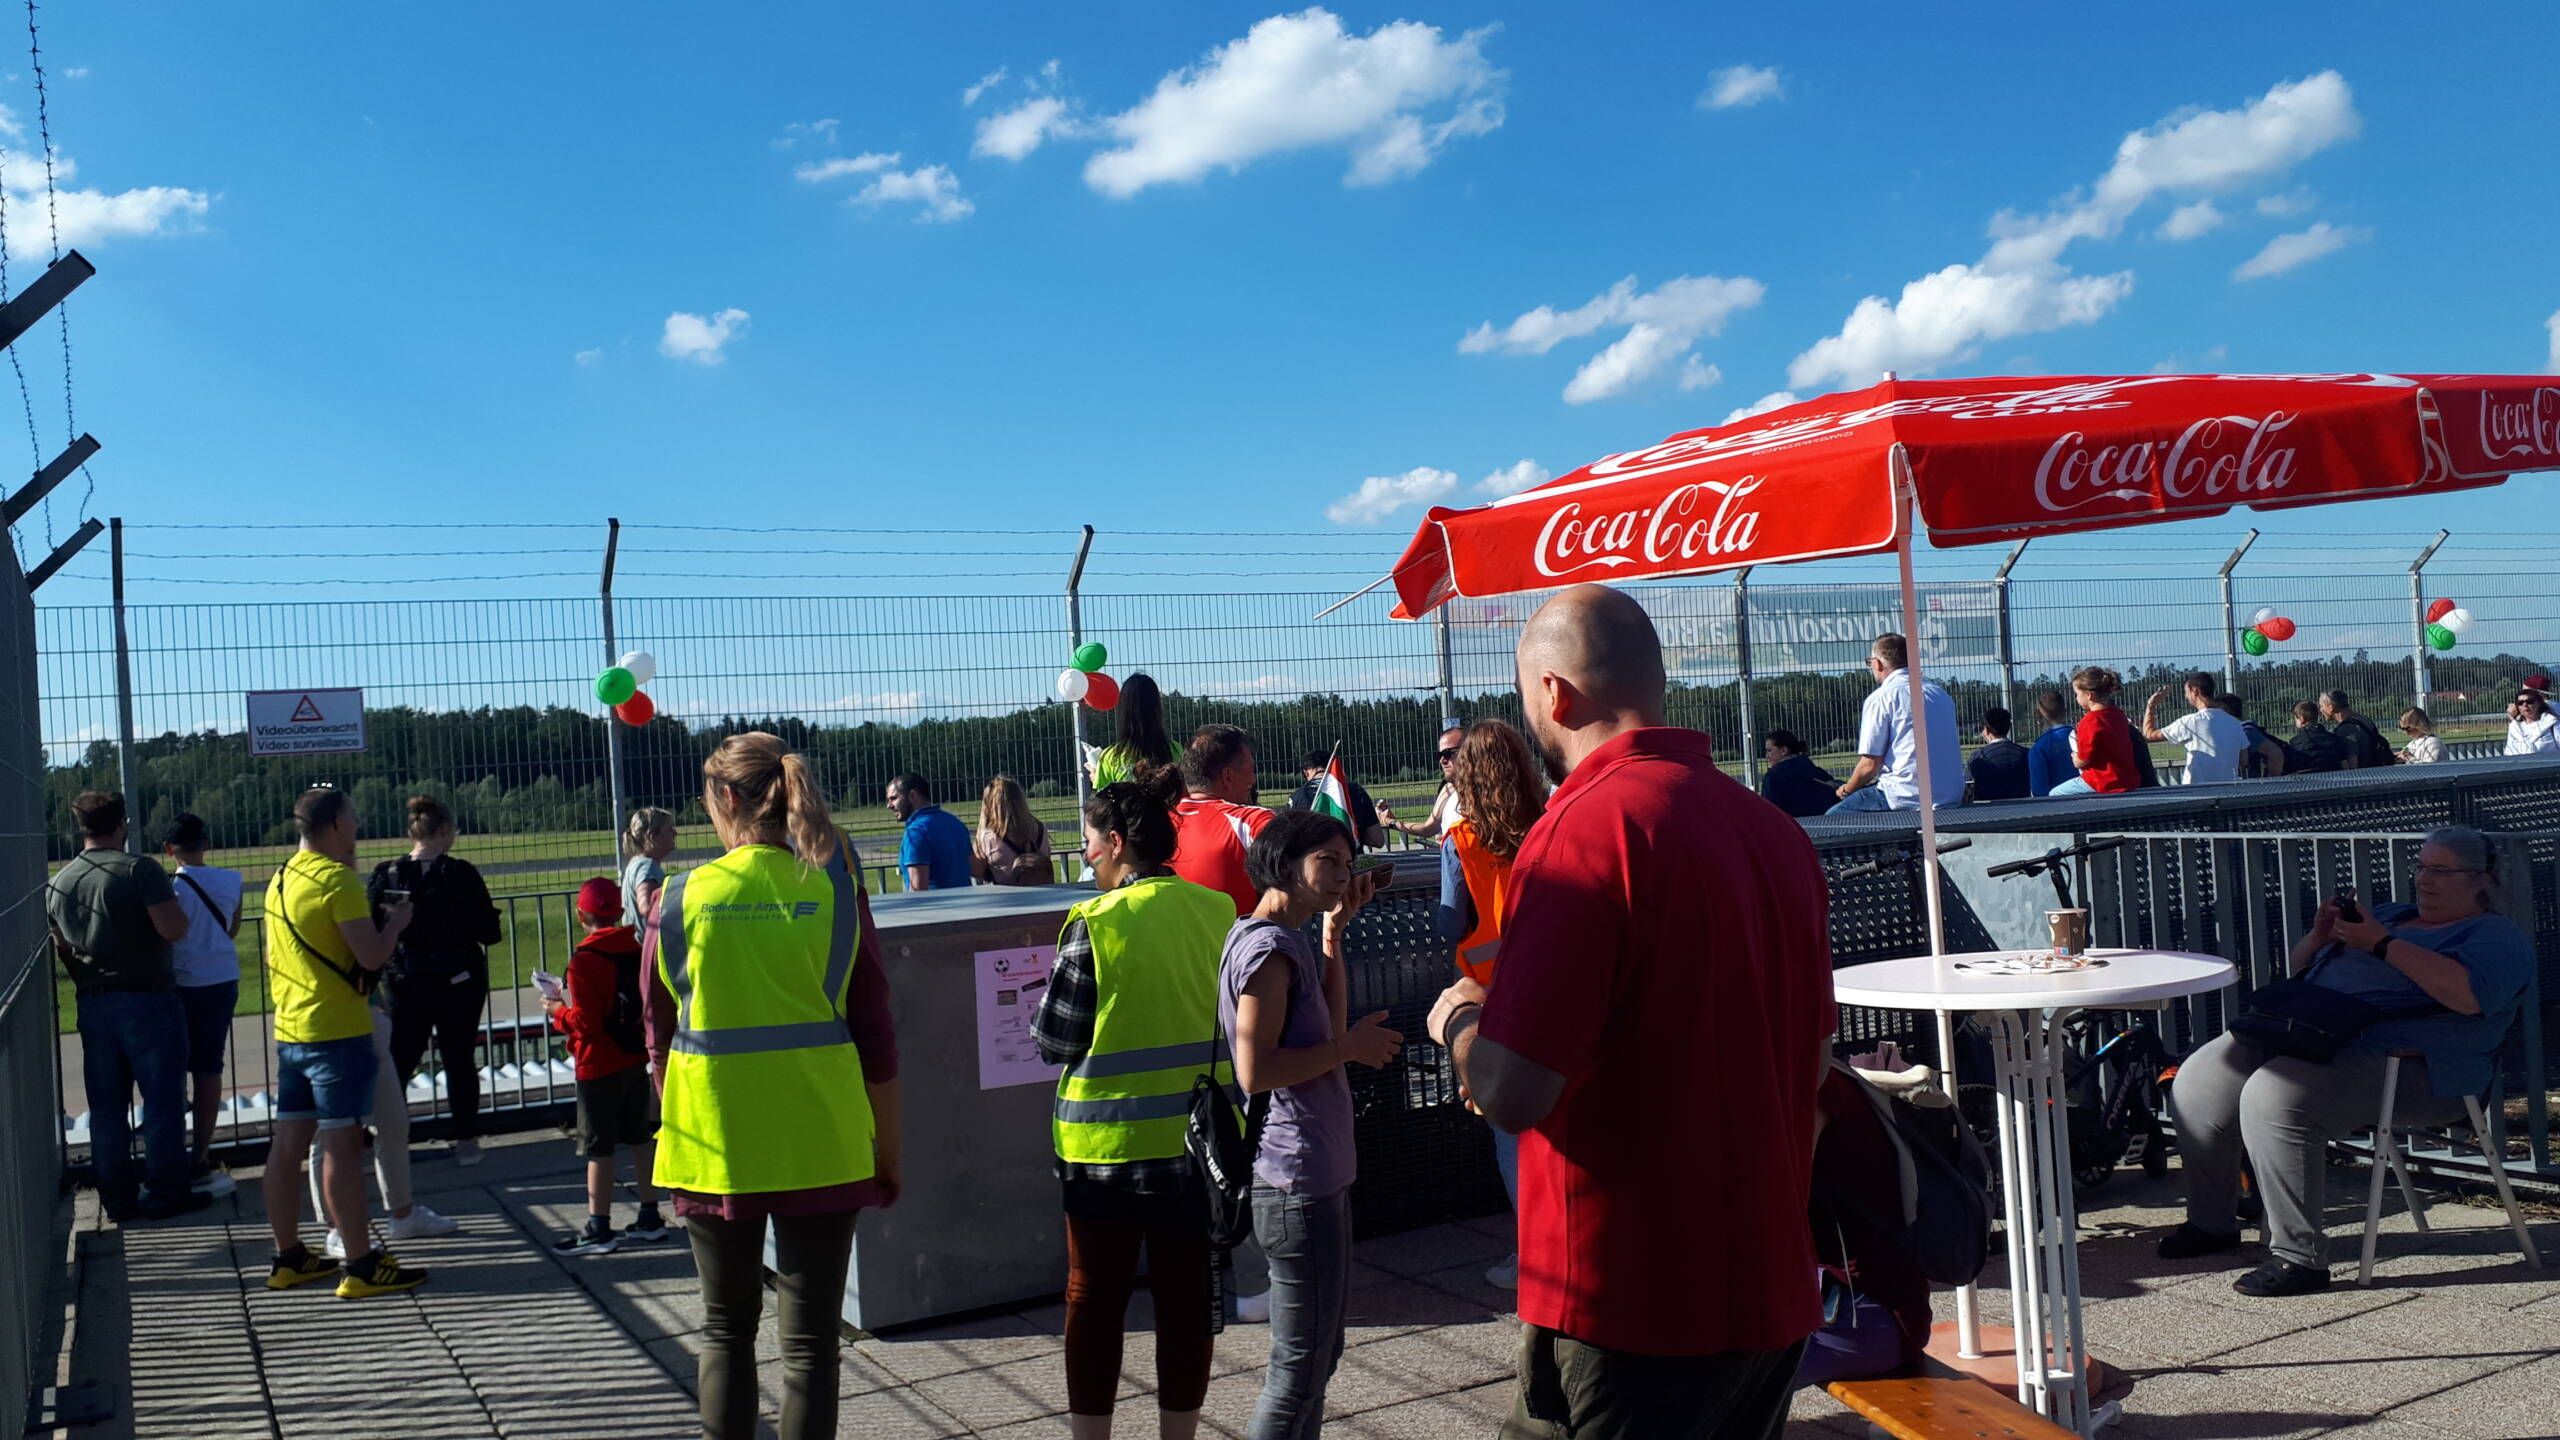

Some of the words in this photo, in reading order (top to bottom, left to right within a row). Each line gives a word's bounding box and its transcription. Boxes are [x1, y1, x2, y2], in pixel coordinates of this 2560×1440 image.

[2034, 410, 2300, 512] Coca-Cola
[1534, 474, 1767, 577] Coca-Cola
[256, 722, 358, 736] Videoüberwacht
[257, 740, 290, 751] Video
[293, 738, 359, 749] surveillance
